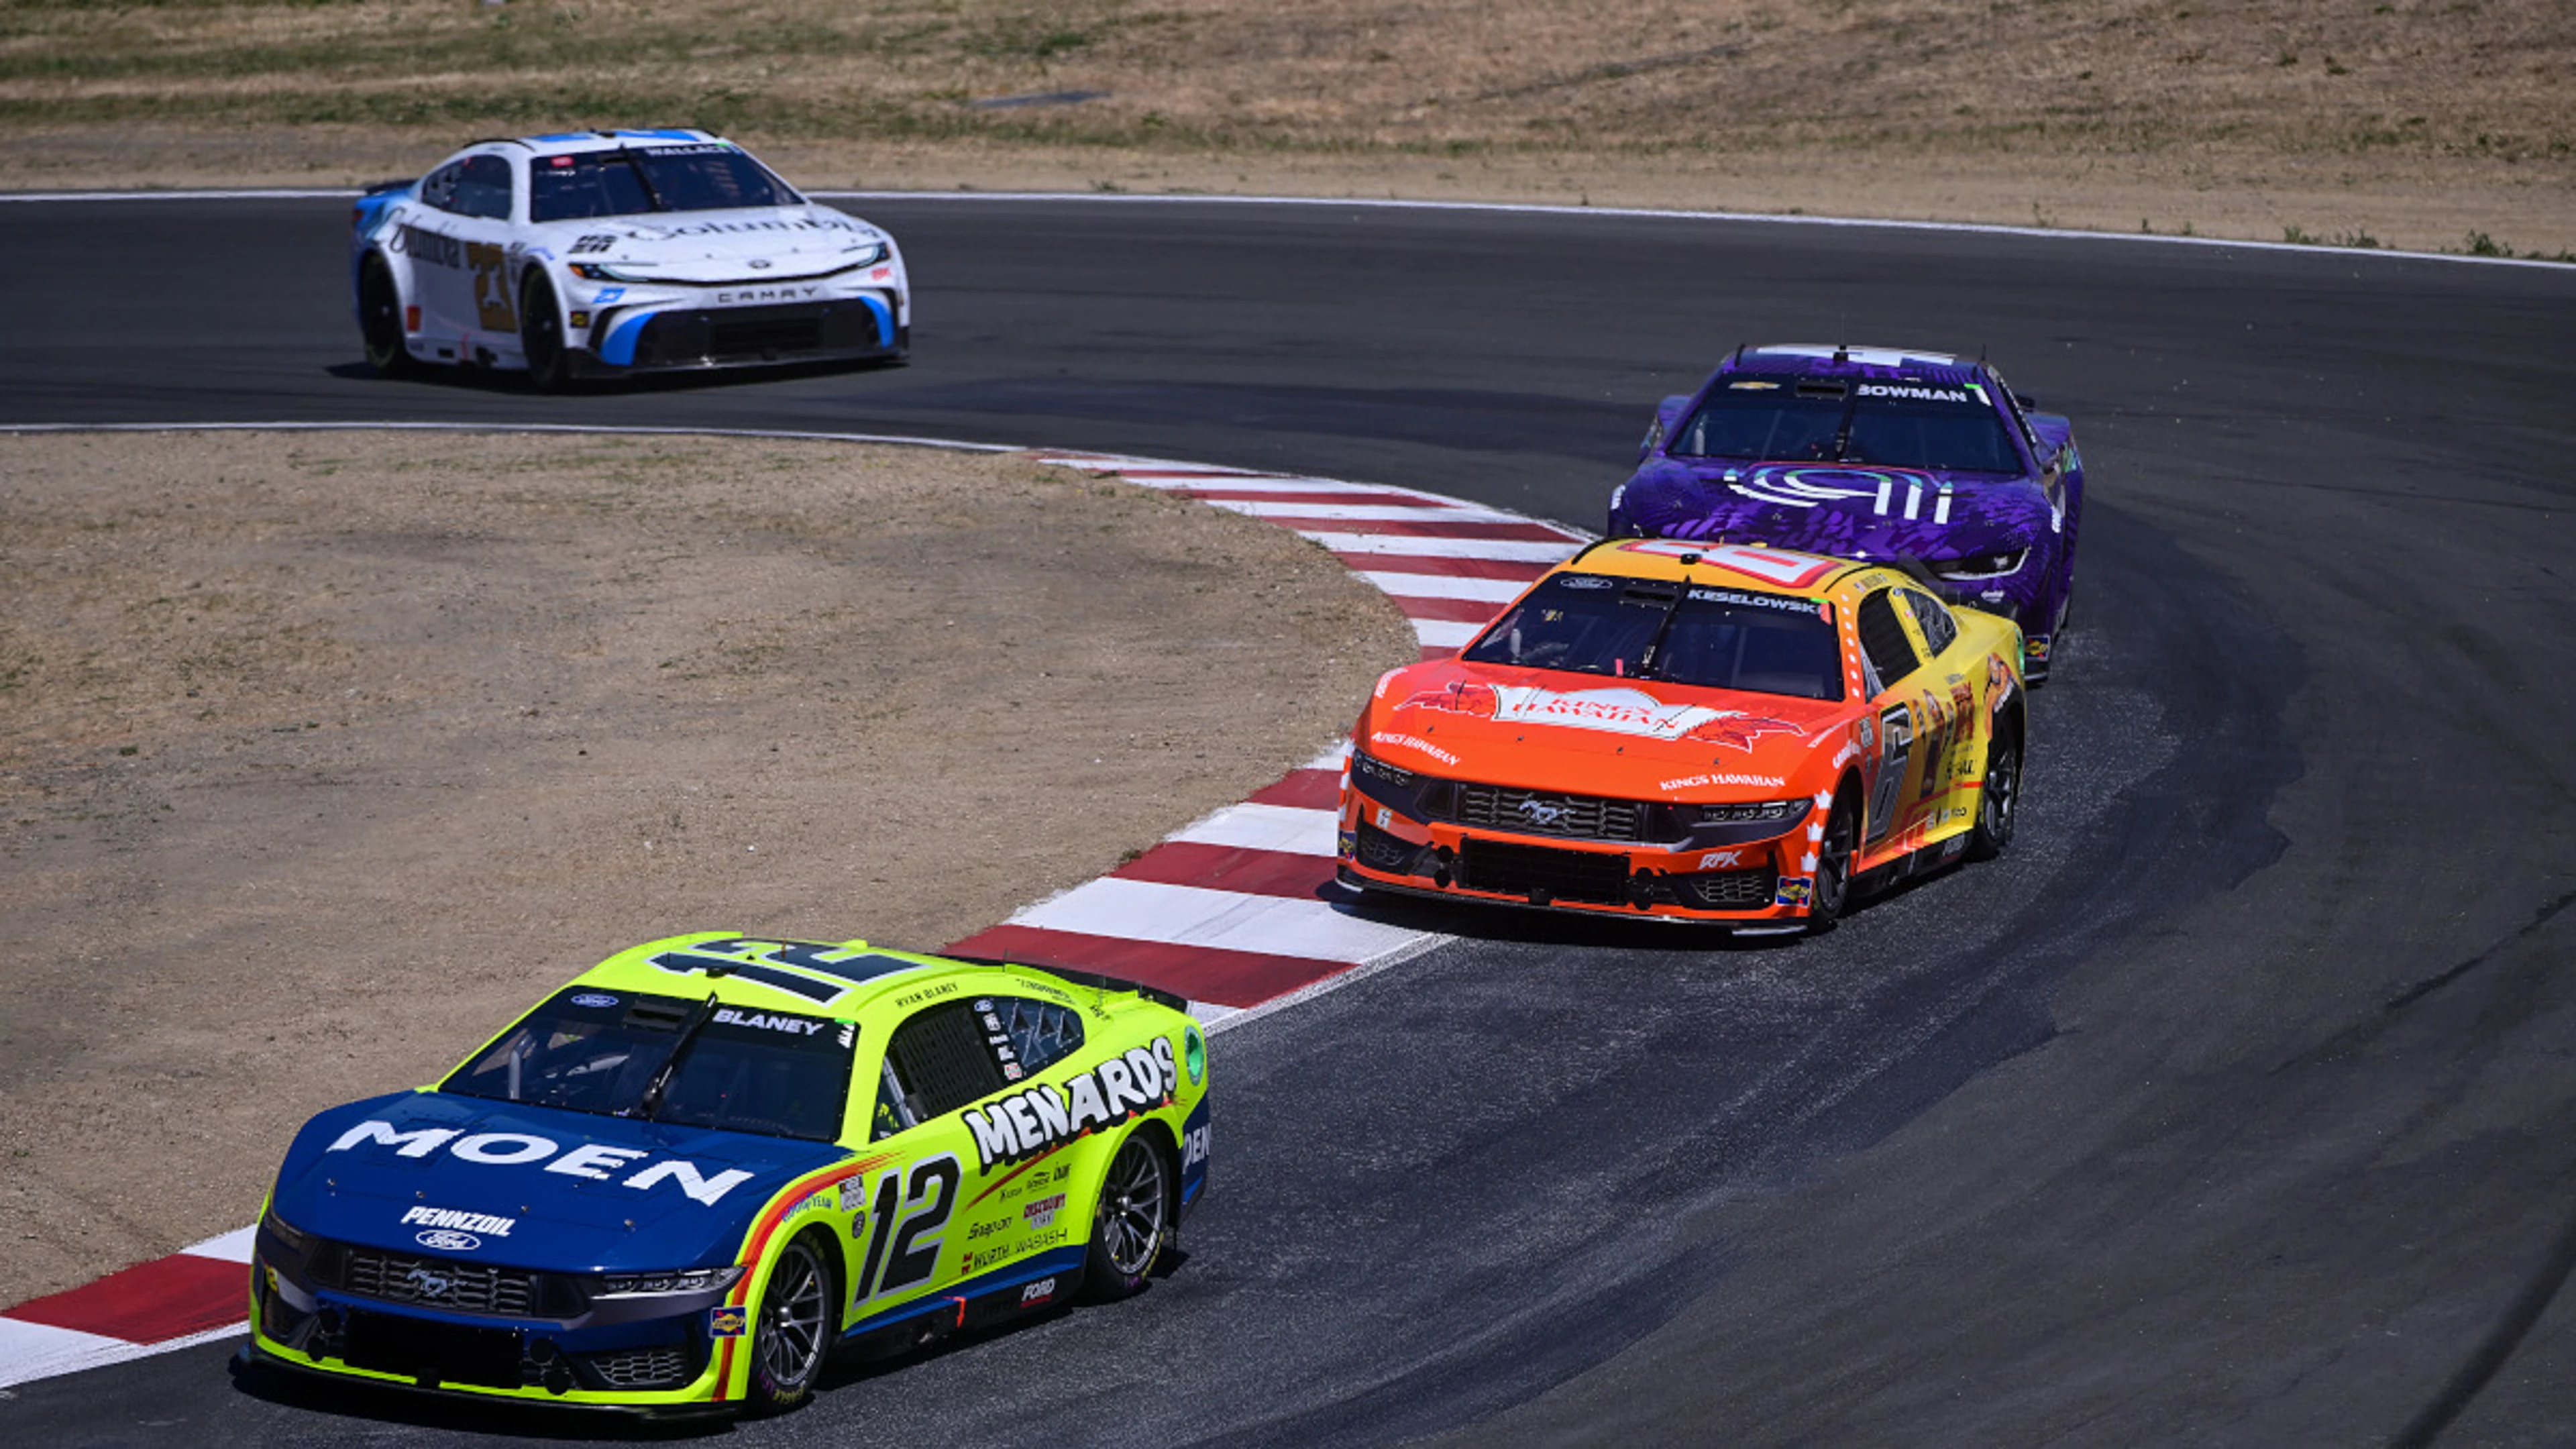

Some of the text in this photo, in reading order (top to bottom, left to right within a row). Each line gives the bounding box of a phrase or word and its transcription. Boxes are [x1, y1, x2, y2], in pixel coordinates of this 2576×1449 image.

[718, 286, 818, 303] CAMRY
[1857, 384, 1967, 402] BOWMAN
[1698, 850, 1743, 869] RFK
[643, 938, 935, 1008] 12
[895, 981, 959, 1007] RYAN BLANEY
[712, 1008, 824, 1035] BLANEY
[963, 1036, 1177, 1168] MENARDS
[326, 1120, 755, 1206] MOEN
[400, 1206, 516, 1237] PENNZOIL
[852, 1150, 963, 1310] 12
[1021, 1277, 1055, 1301] FORD
